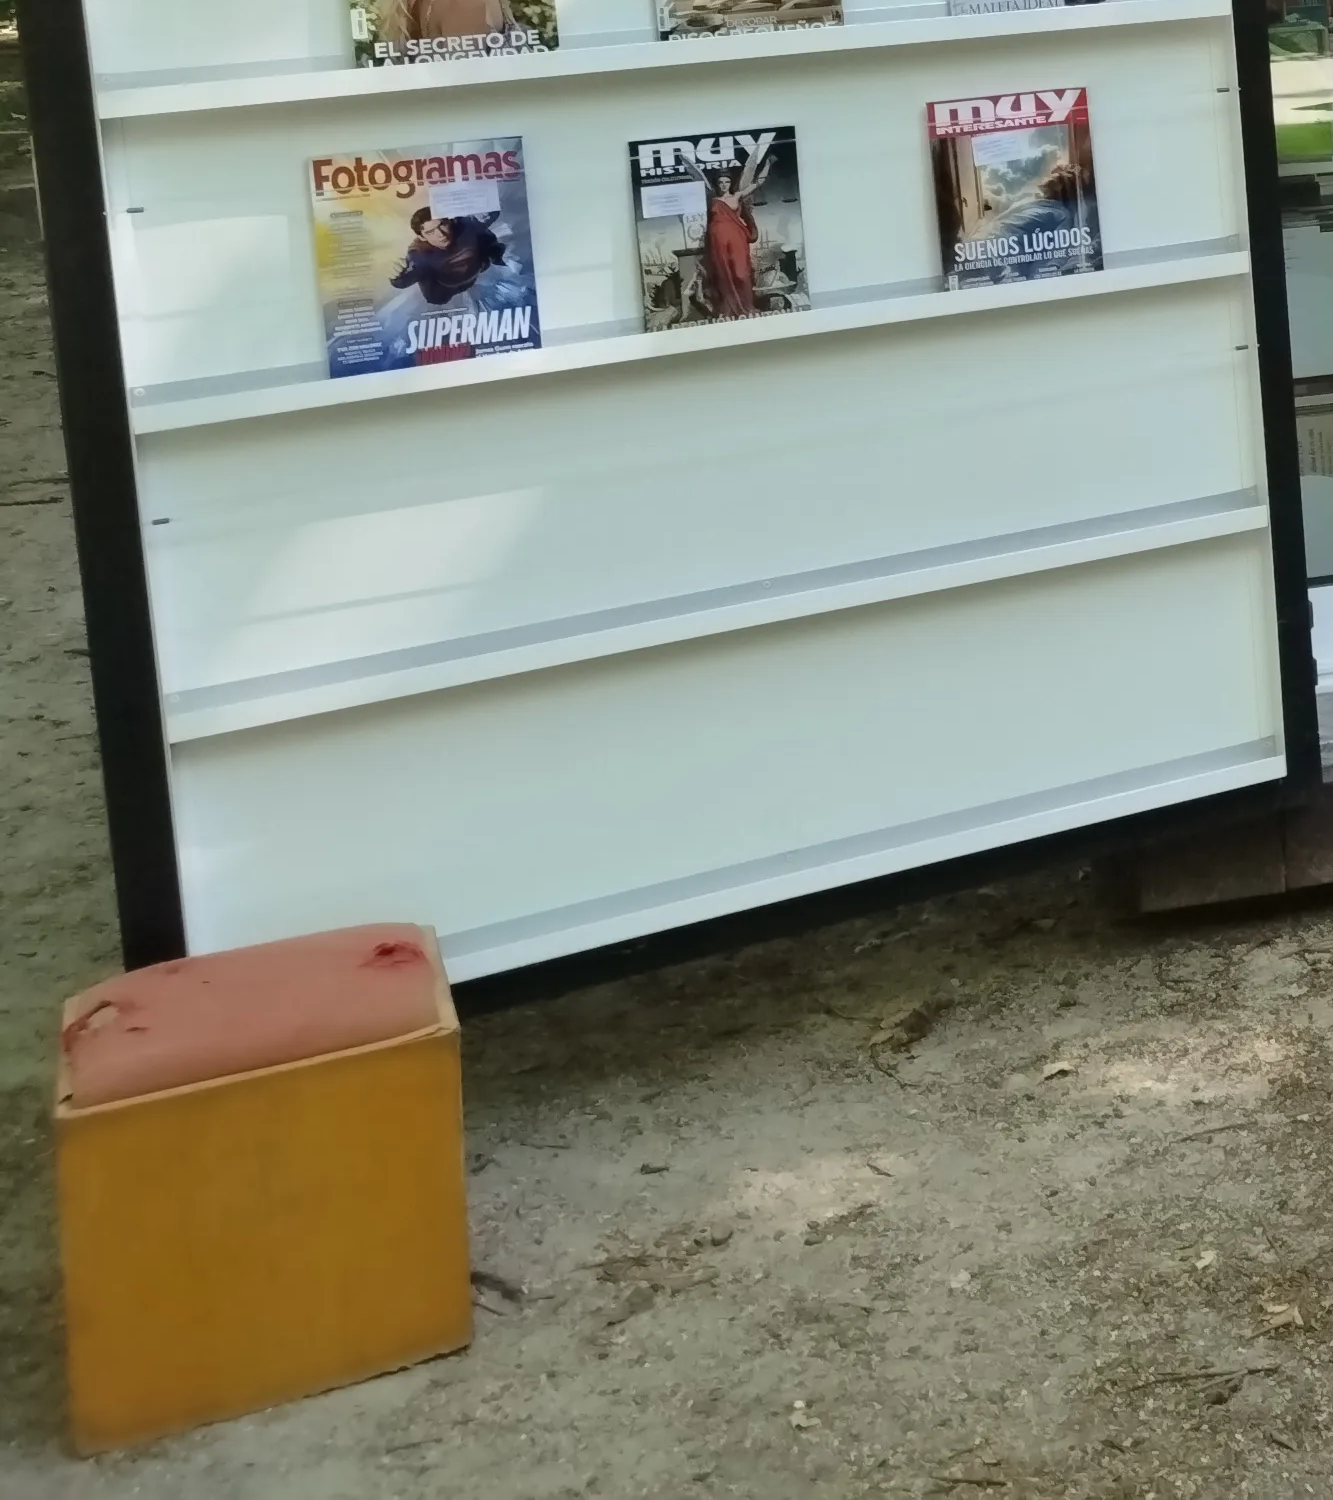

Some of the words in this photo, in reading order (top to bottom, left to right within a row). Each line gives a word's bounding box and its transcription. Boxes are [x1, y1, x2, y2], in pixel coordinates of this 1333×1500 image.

[374, 42, 401, 58] EL
[406, 32, 504, 56] SECRETO
[511, 29, 540, 47] DE
[936, 115, 1047, 136] INTERESANTE
[312, 150, 521, 199] Fotogramas
[954, 234, 1020, 263] SUEÑOS
[1023, 226, 1092, 253] LÚCIDOS
[954, 263, 964, 272] LA
[964, 259, 992, 271] CIENCIA
[1003, 252, 1043, 266] CONTROLAR
[1043, 251, 1052, 260] LO
[1053, 249, 1067, 259] QUE
[405, 305, 532, 355] SUPERMAN
